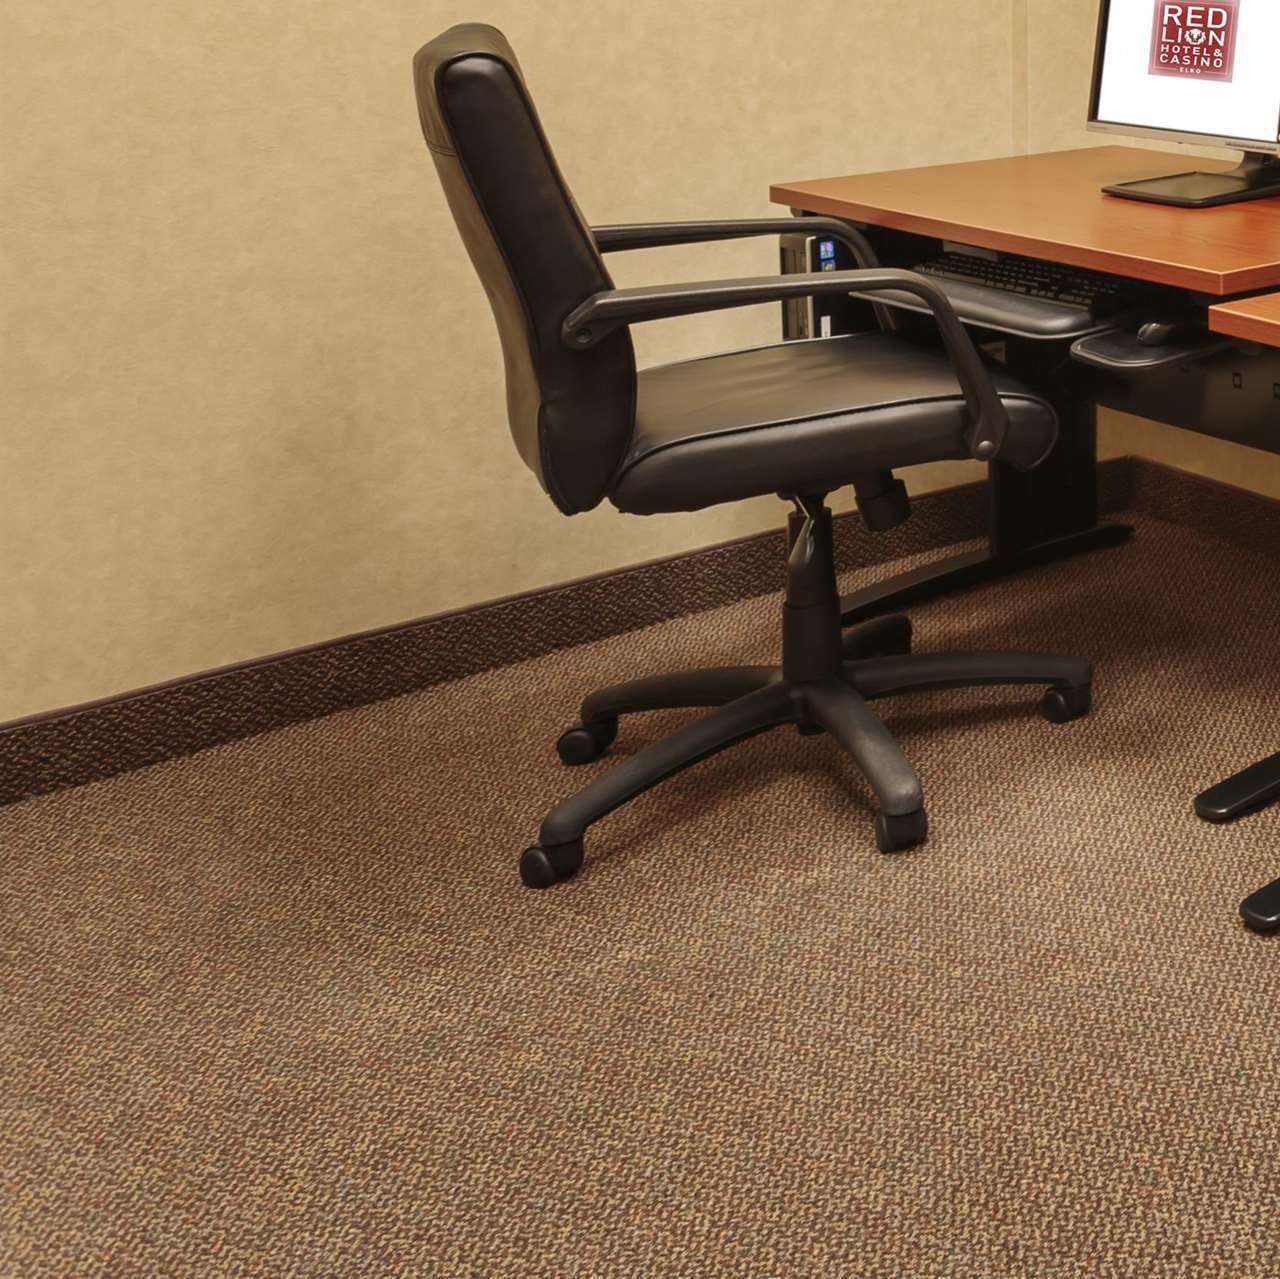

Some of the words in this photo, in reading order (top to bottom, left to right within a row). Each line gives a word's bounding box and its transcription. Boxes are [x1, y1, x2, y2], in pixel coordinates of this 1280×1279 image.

[1163, 4, 1228, 29] RED
[1159, 53, 1223, 68] CASINO
[1179, 66, 1202, 74] ELKO
